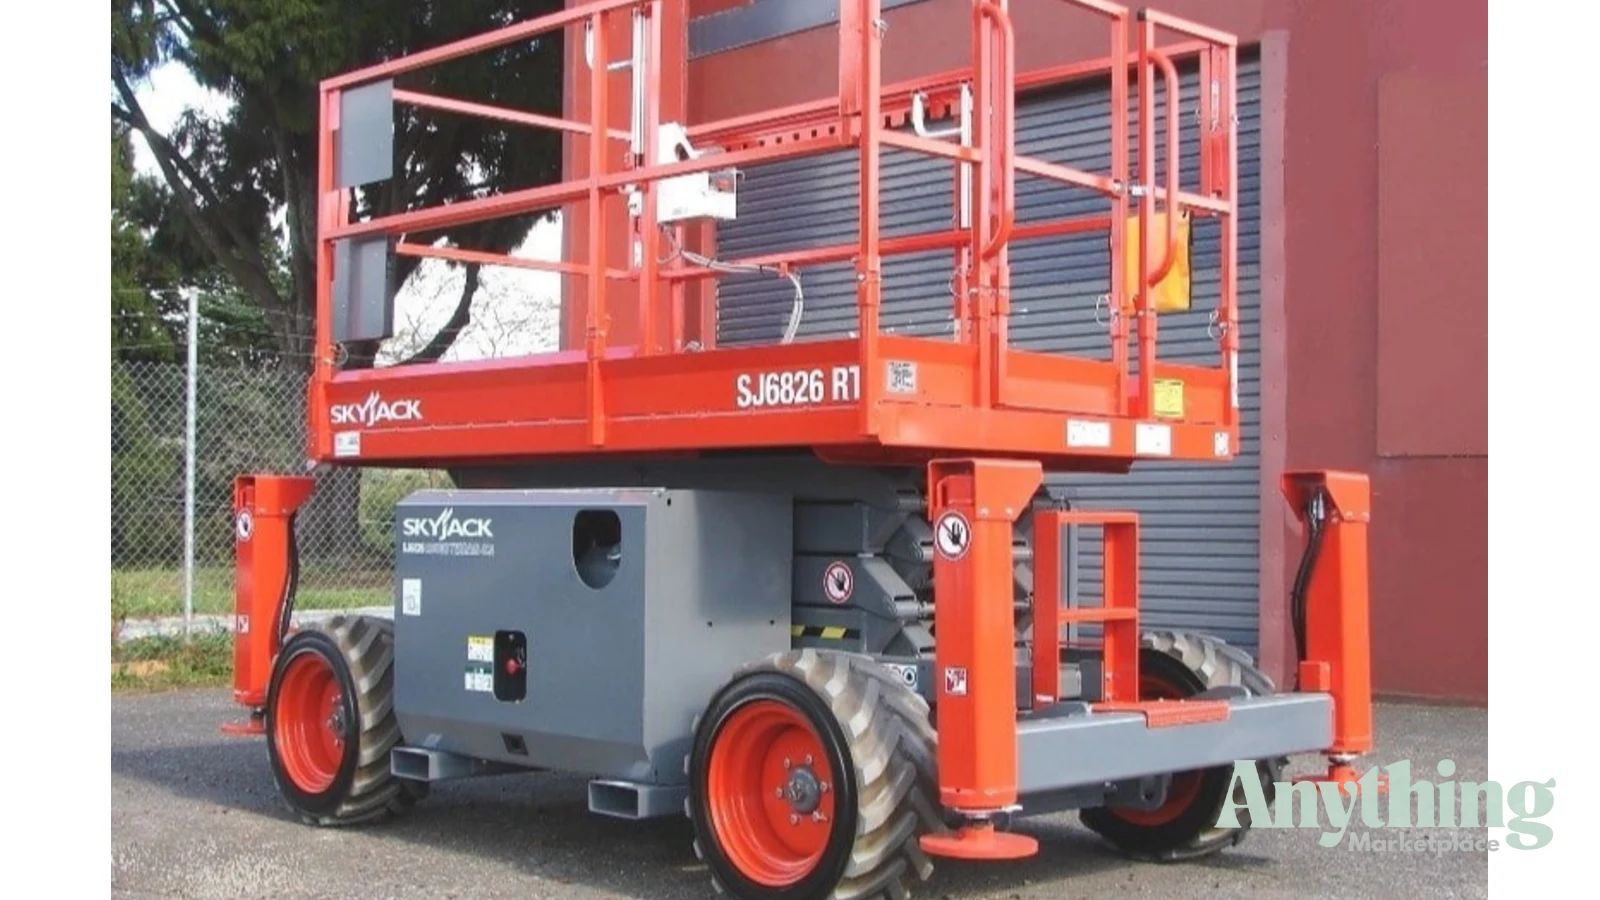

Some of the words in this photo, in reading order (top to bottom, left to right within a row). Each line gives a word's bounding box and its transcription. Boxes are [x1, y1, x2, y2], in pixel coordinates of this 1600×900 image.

[737, 369, 824, 407] SJ6826
[330, 390, 423, 427] SKYJACK
[402, 507, 493, 541] SKYJACK
